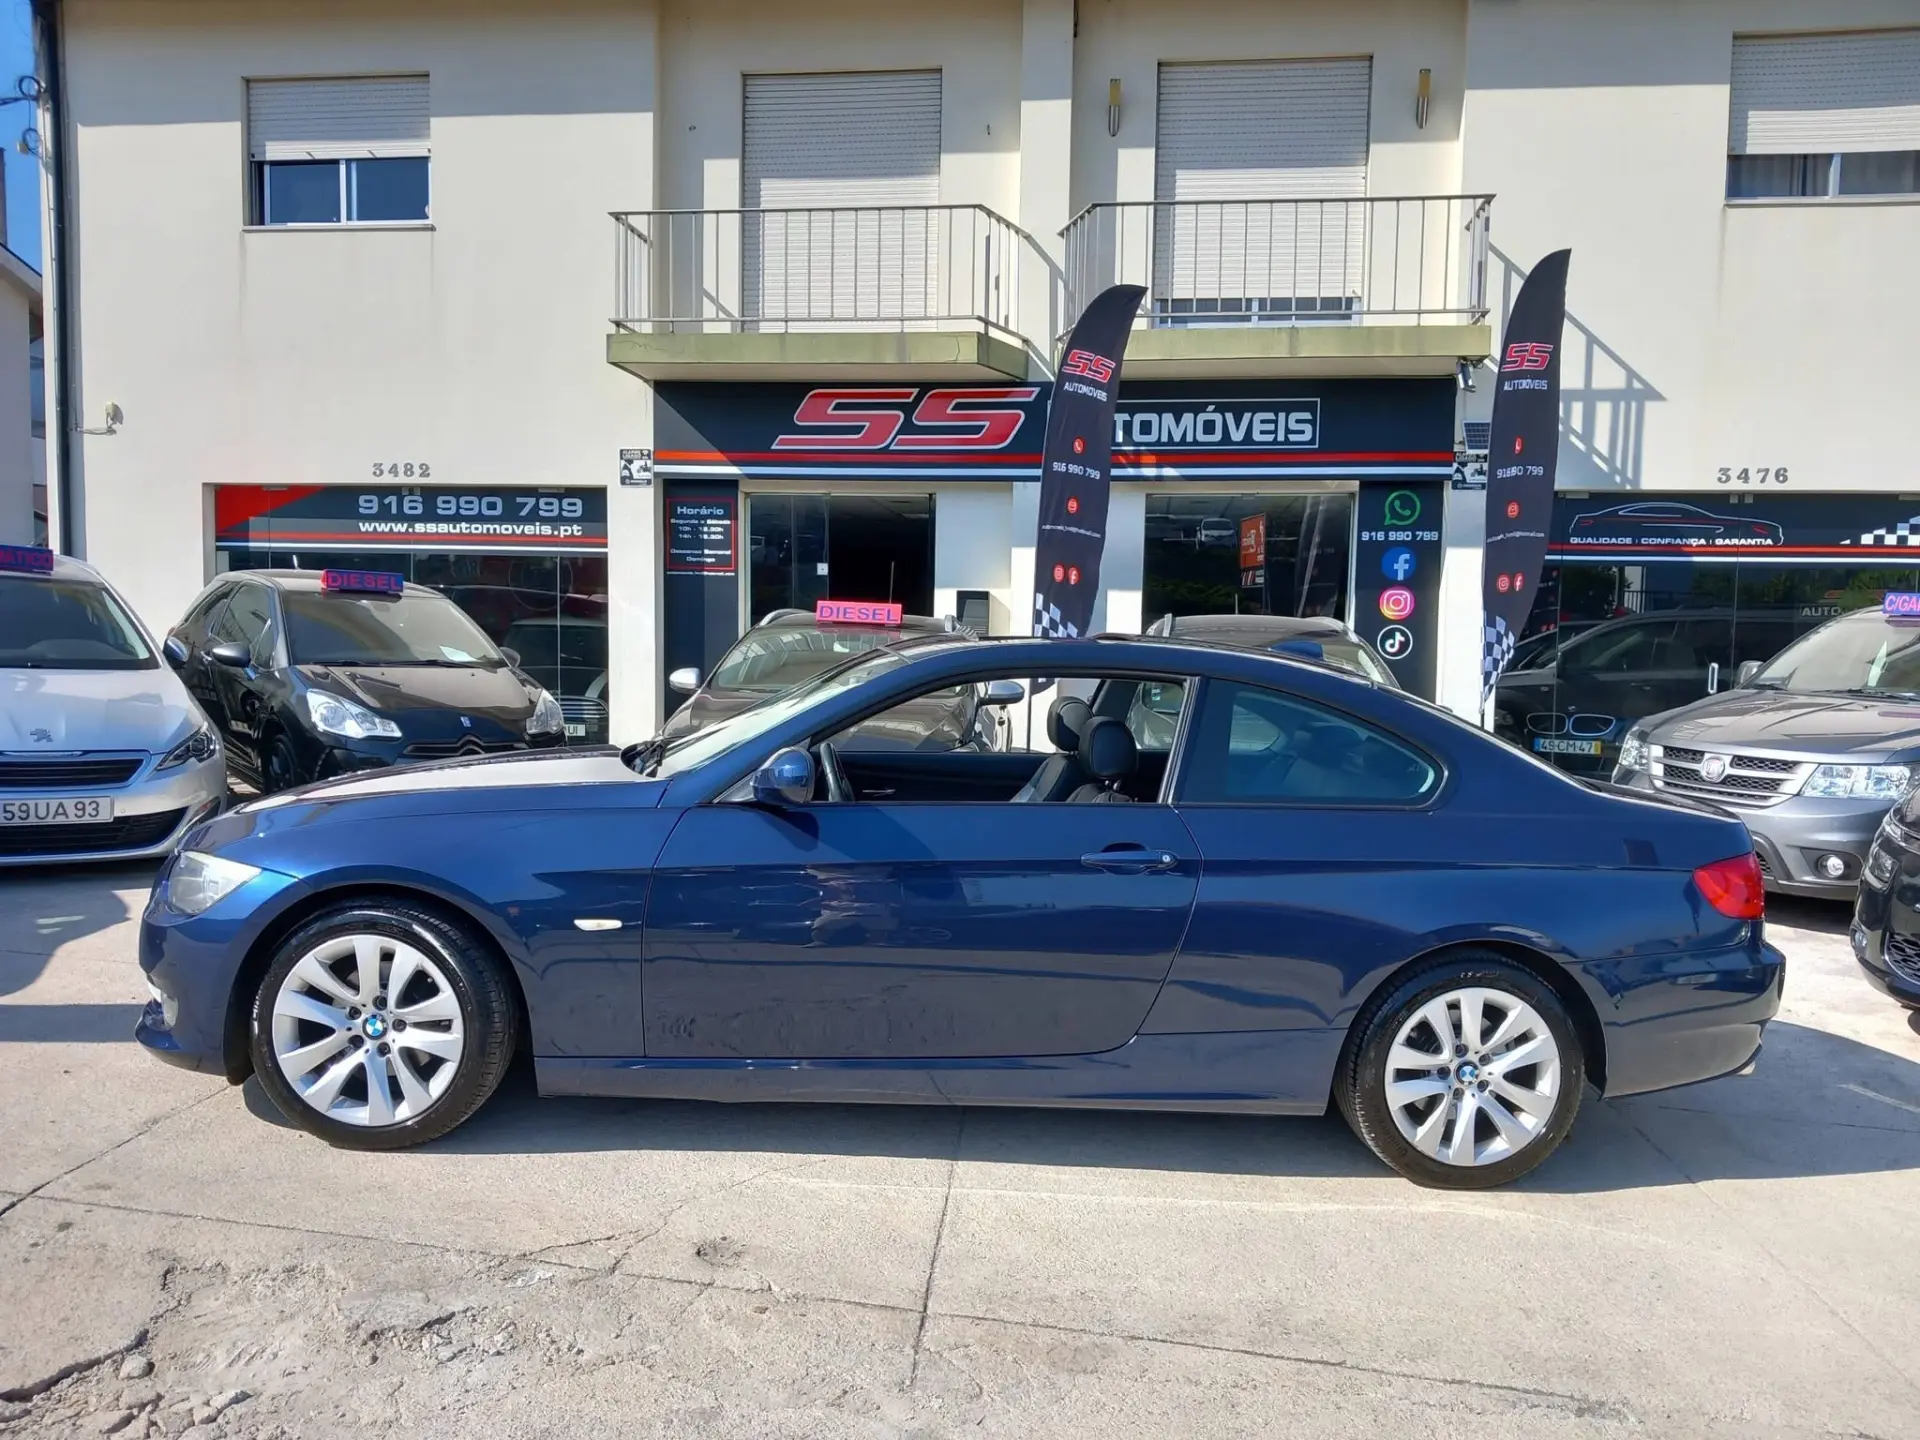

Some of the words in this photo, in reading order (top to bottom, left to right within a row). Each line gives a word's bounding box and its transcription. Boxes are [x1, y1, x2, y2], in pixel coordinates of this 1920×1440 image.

[1500, 342, 1554, 372] SS
[1061, 349, 1117, 384] SS
[770, 387, 1042, 450] SS
[1114, 405, 1313, 443] TOMÓVEIS
[372, 462, 431, 478] 3482
[1052, 461, 1067, 472] 916
[1067, 463, 1084, 475] 990
[1085, 467, 1101, 480] 799
[1525, 465, 1544, 476] 799
[1717, 467, 1789, 484] 3476
[358, 494, 423, 515] 916
[436, 495, 503, 516] 990
[516, 496, 583, 518] 799
[677, 505, 725, 516] Horário
[358, 521, 582, 538] www.ssautomoveis.pt
[1361, 531, 1385, 541] 916
[1388, 531, 1412, 541] 990
[1415, 531, 1439, 541] 799
[1569, 536, 1633, 545] QUALIDADE
[1641, 537, 1707, 547] CONFIANÇA
[1715, 538, 1774, 546] GARANTIA
[327, 571, 402, 590] DIESEL
[1885, 594, 1920, 612] C/GA
[820, 605, 899, 622] DIESEL
